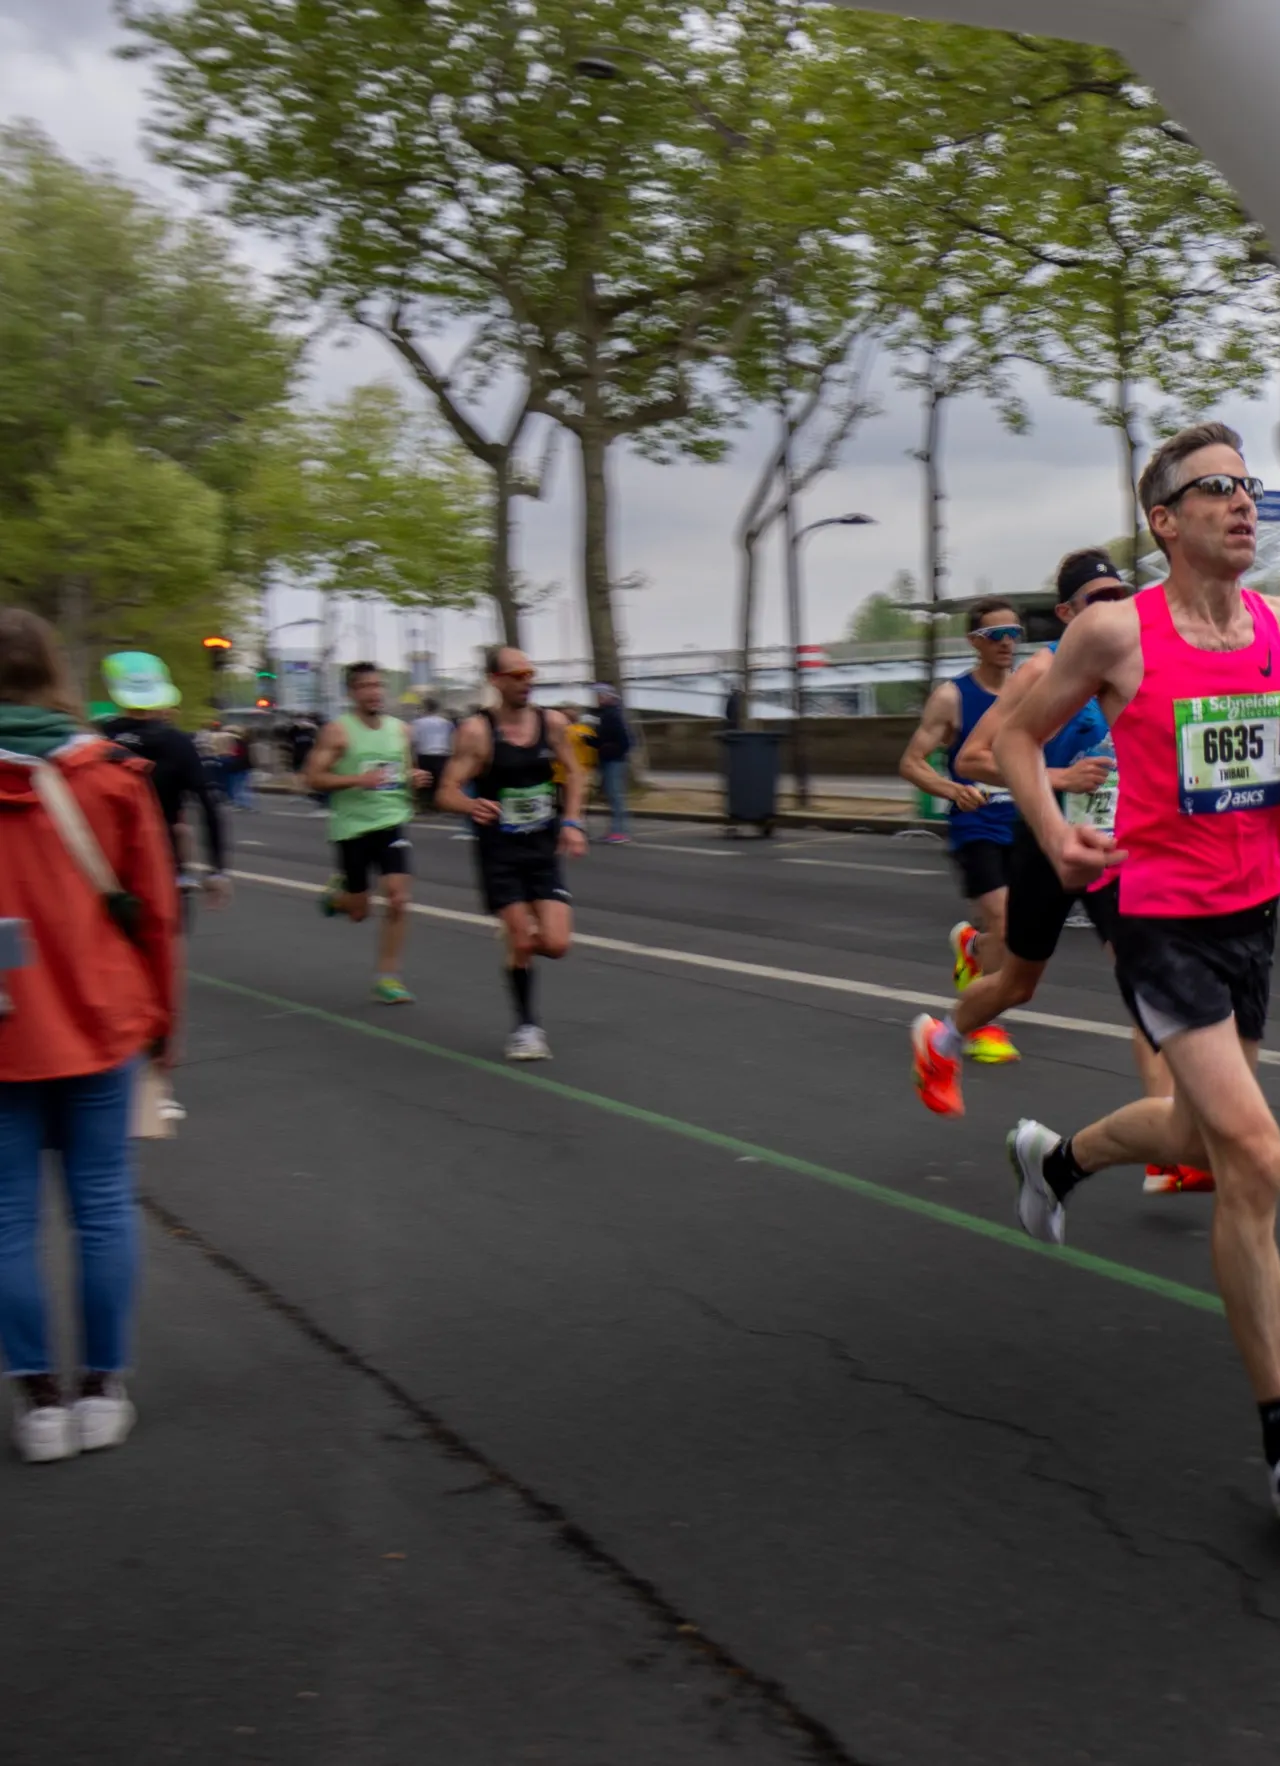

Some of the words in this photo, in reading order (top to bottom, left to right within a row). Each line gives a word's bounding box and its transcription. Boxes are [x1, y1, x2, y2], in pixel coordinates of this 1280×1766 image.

[1209, 694, 1280, 712] Schneider
[1203, 724, 1264, 764] 6635
[1219, 766, 1250, 781] THIBAUT
